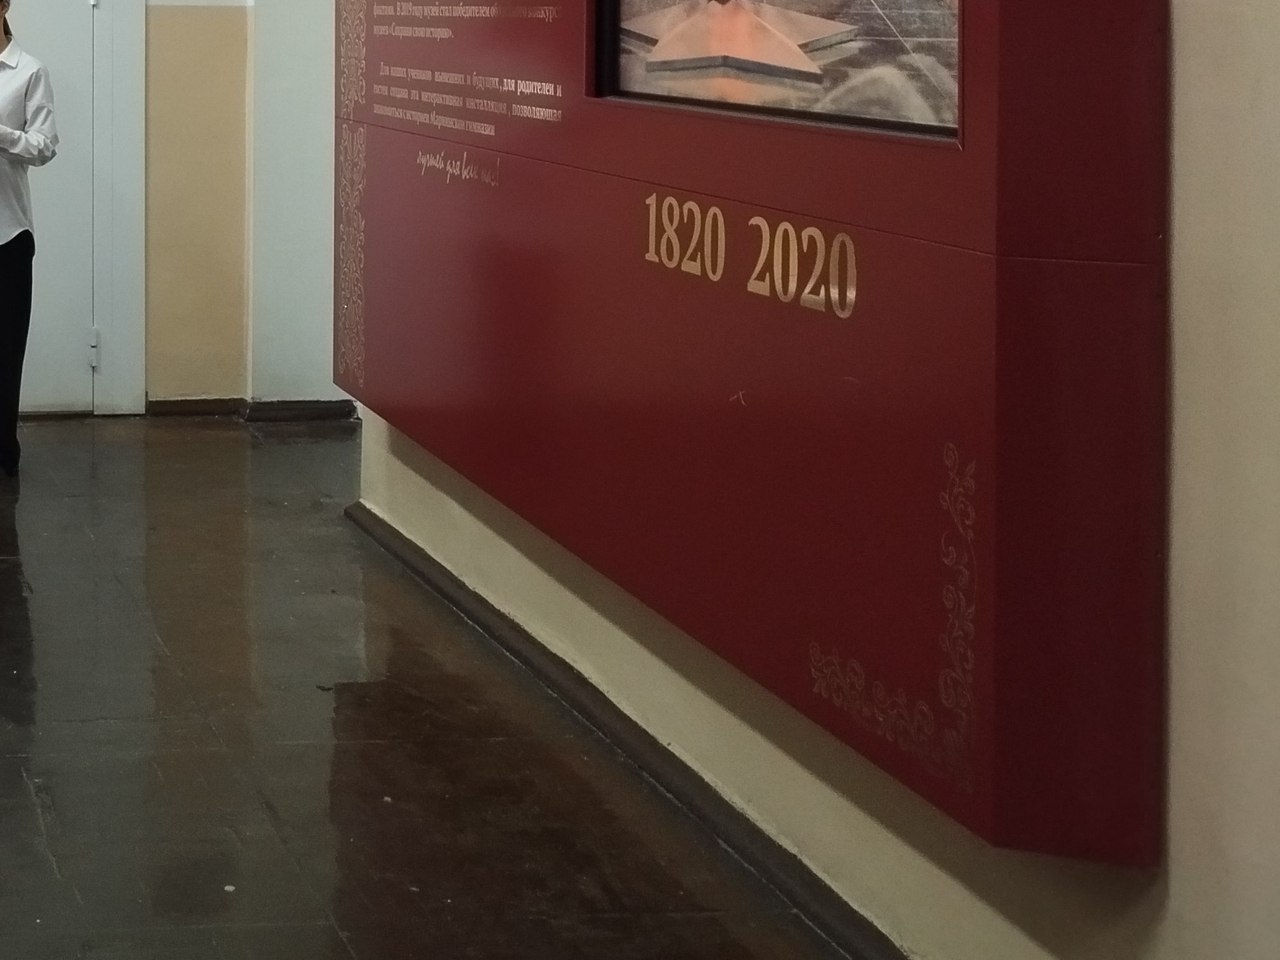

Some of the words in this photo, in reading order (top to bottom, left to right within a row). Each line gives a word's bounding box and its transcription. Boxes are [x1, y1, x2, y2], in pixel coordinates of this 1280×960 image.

[503, 78, 515, 92] для
[512, 103, 562, 122] позволяющая
[645, 193, 725, 281] 1820
[747, 216, 857, 319] 2020
